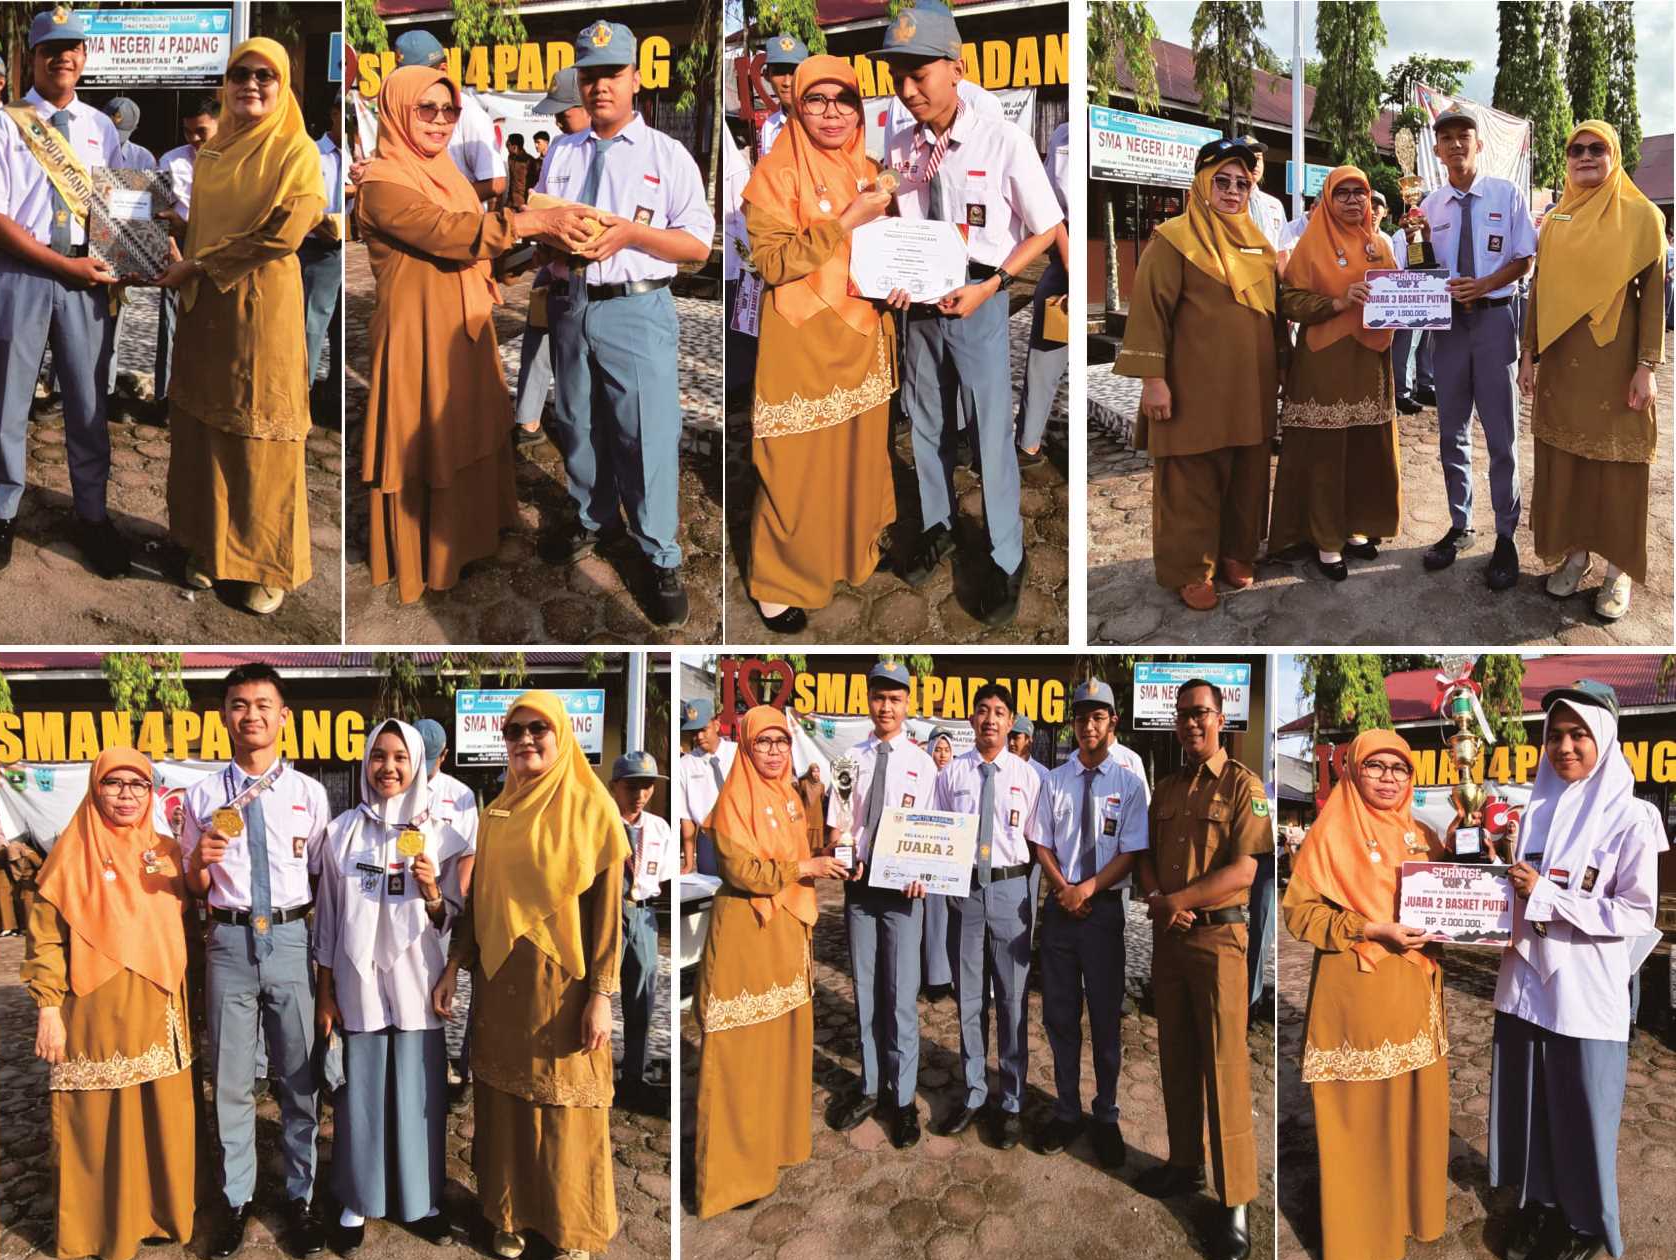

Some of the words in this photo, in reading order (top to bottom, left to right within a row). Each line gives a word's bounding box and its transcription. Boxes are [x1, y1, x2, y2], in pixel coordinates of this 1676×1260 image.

[110, 36, 155, 54] NEGERI
[158, 37, 166, 53] 4
[170, 36, 220, 54] PADANG
[1098, 131, 1122, 150] SMA
[1126, 136, 1166, 157] NEGERI
[1168, 143, 1174, 157] 4
[1366, 294, 1390, 304] JUARA
[1391, 294, 1397, 304] 3
[1398, 294, 1426, 304] BASKET
[1427, 294, 1450, 304] PUTRA
[1140, 685, 1158, 700] SMA
[464, 715, 487, 733] SMA
[896, 840, 943, 856] JUARA
[945, 845, 954, 857] 2
[1404, 895, 1434, 908] JUARA
[1436, 897, 1443, 909] 2
[1445, 897, 1479, 911] BASKET
